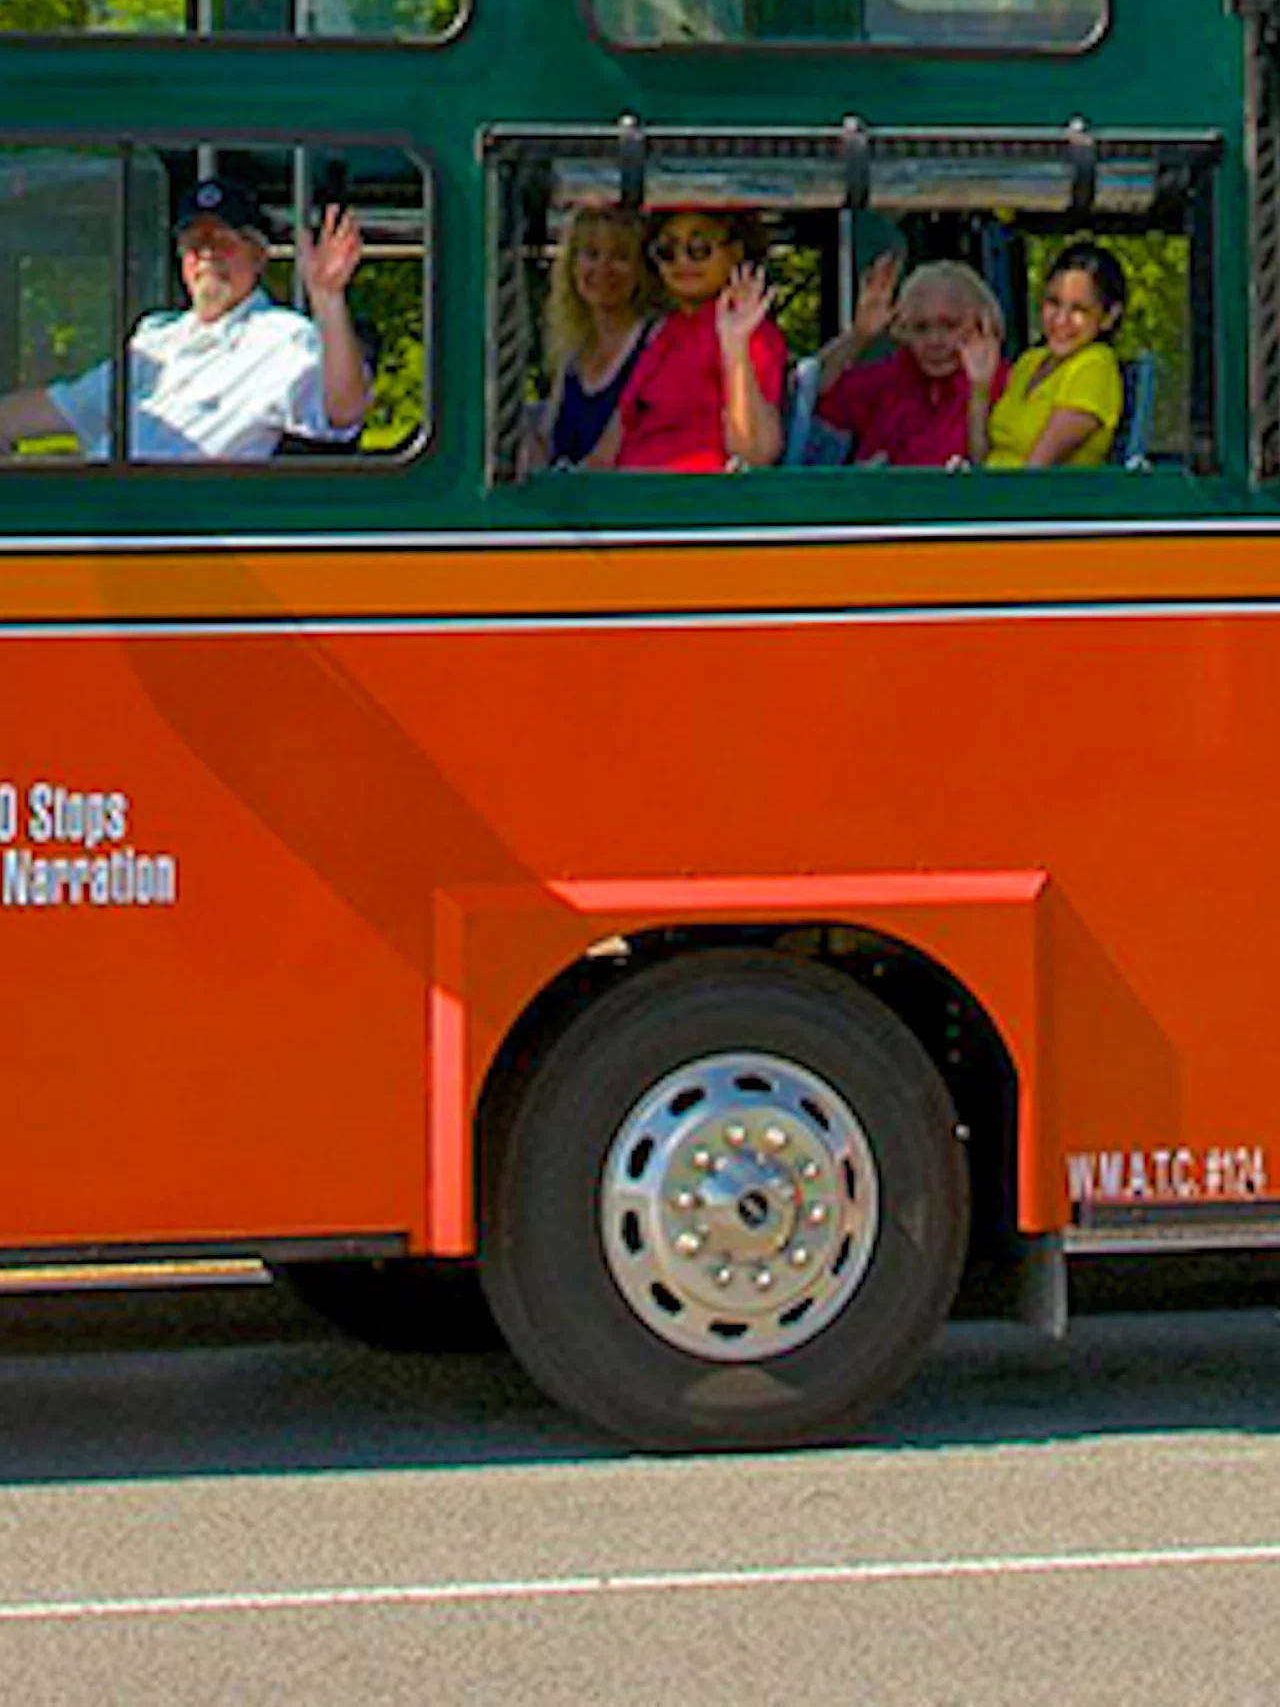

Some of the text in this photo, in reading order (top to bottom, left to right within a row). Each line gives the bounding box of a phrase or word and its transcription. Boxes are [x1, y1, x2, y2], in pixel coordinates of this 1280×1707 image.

[27, 781, 130, 849] Stops
[1, 845, 177, 907] Narration
[1205, 1145, 1267, 1200] #124
